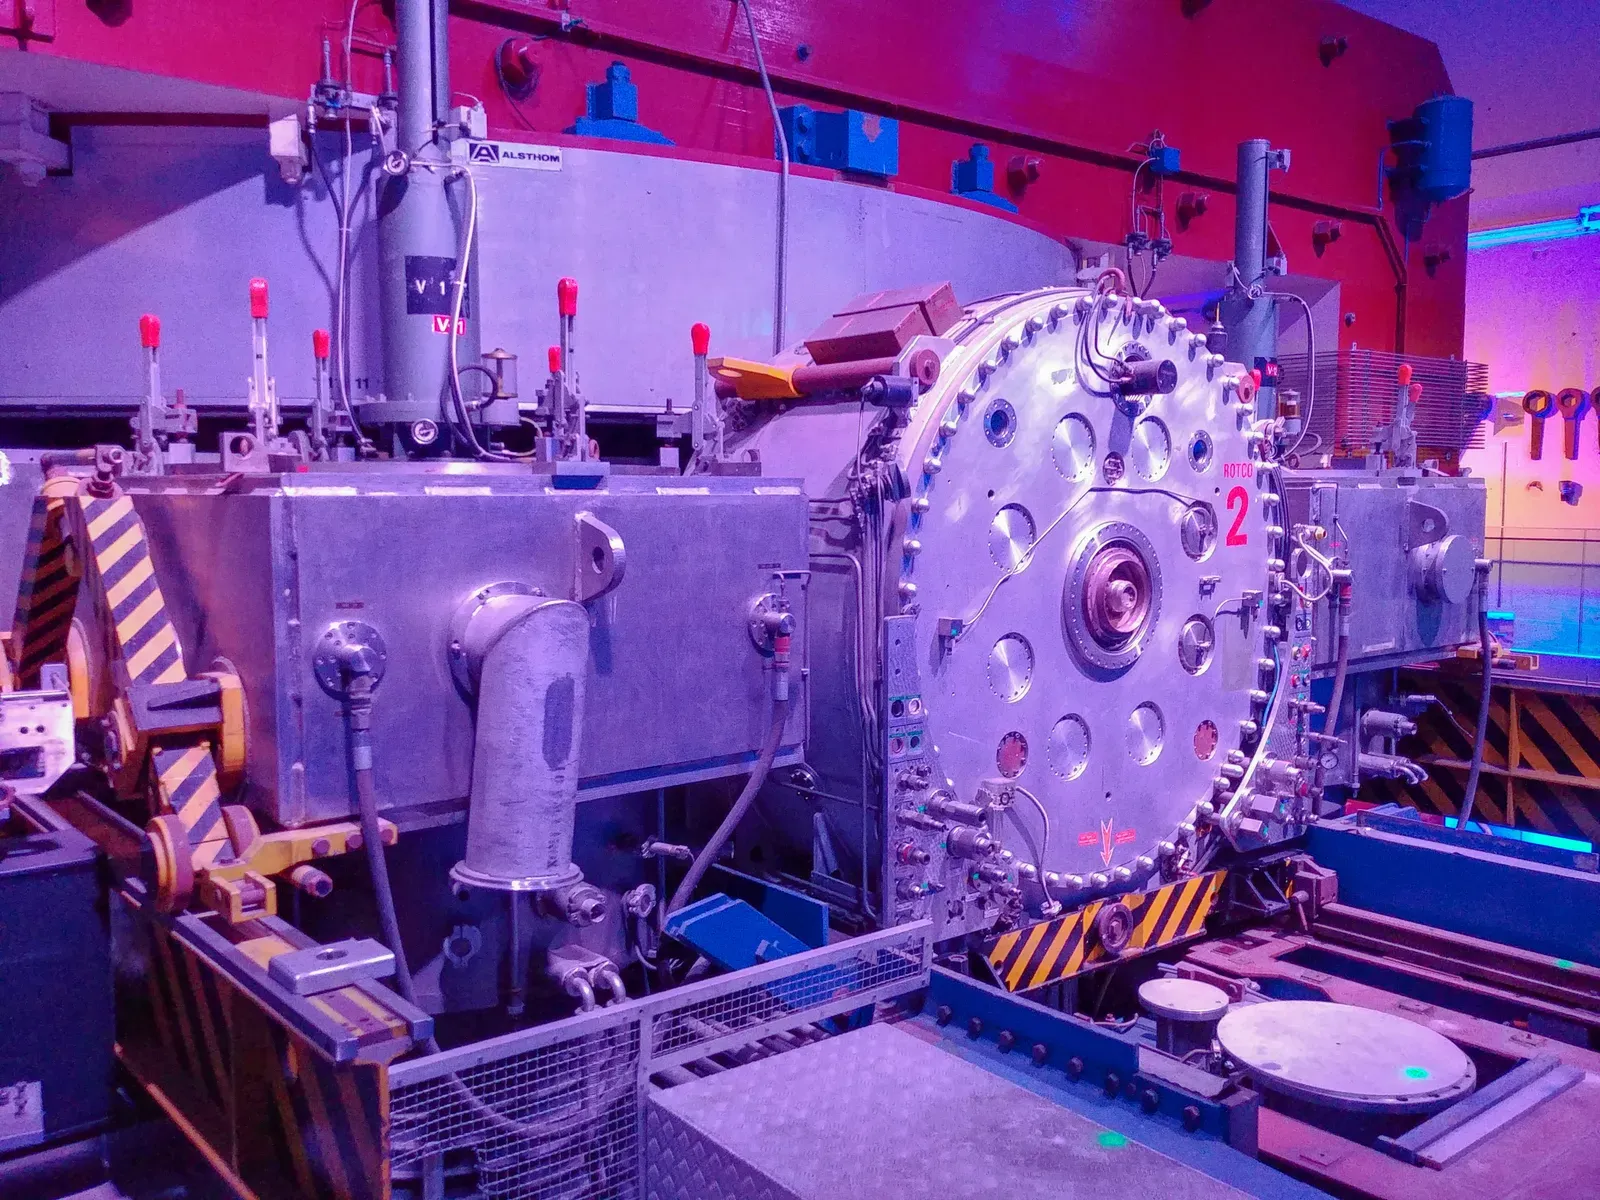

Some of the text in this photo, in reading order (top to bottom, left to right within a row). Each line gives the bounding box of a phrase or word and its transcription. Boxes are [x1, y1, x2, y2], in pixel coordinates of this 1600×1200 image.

[502, 151, 560, 162] ALSTHOM
[1223, 462, 1253, 478] ROTCO
[1226, 486, 1248, 546] 2
